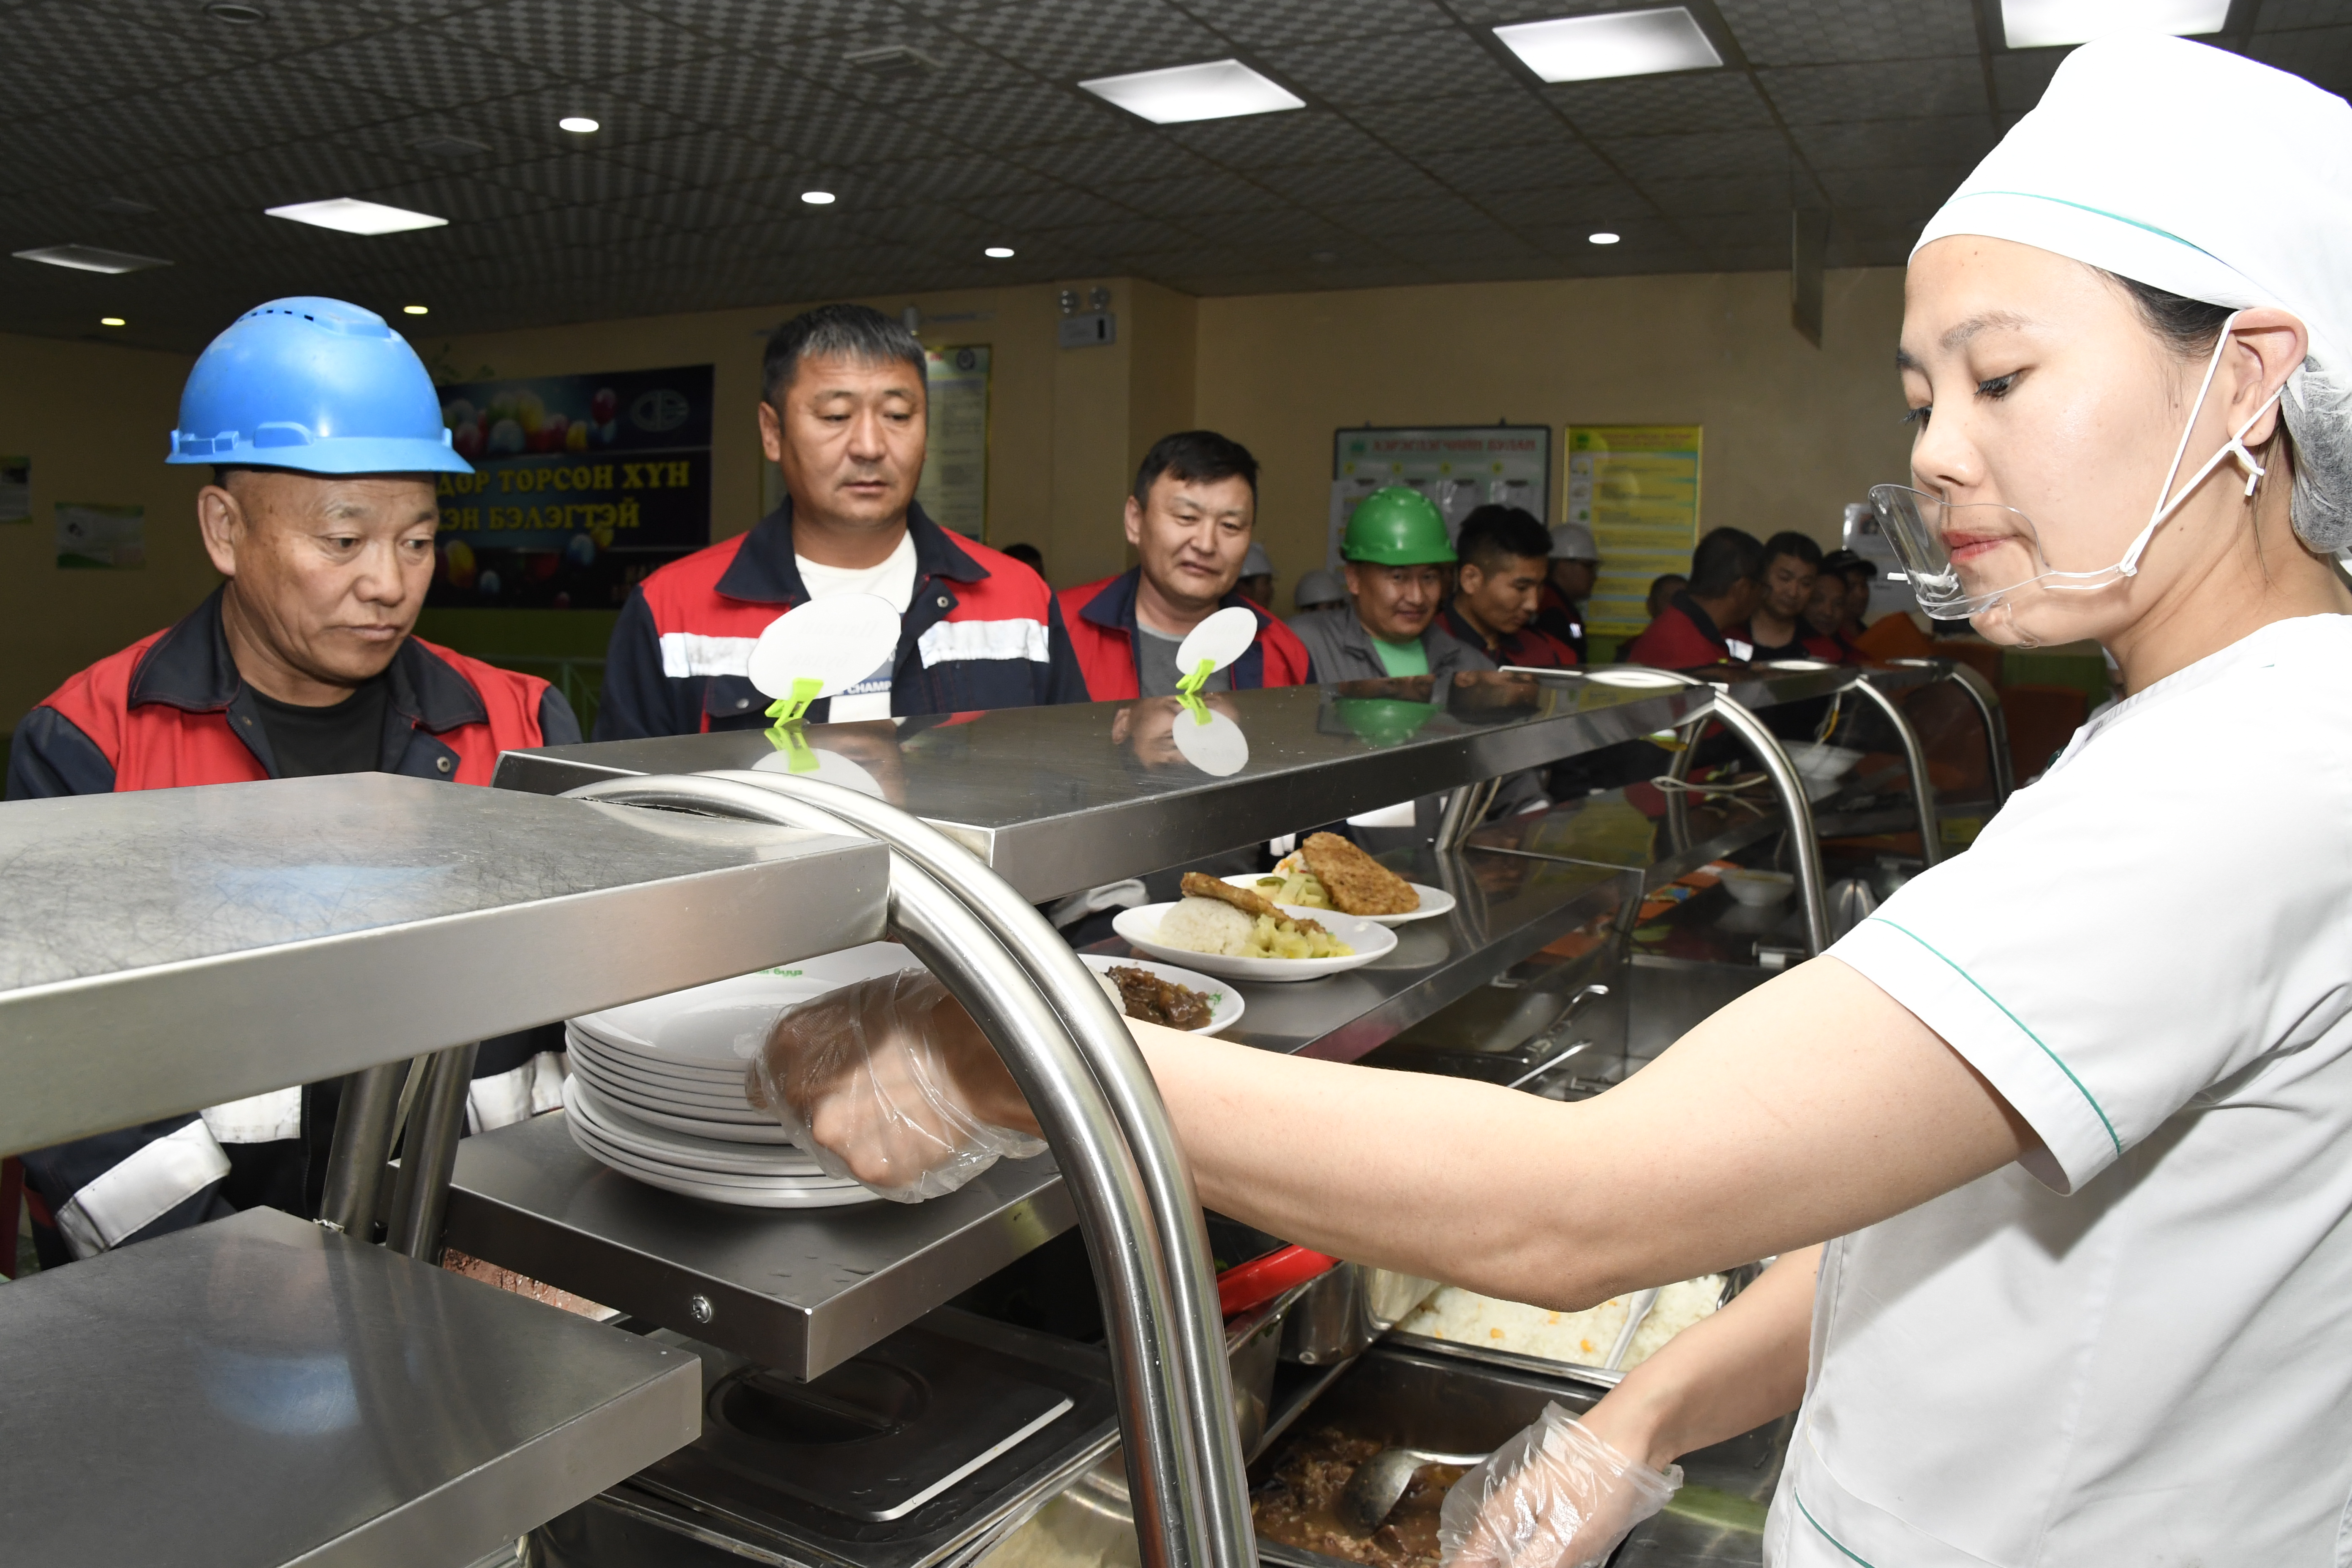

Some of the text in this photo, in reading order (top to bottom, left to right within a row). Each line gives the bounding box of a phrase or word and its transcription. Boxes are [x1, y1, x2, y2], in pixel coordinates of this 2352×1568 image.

[499, 466, 613, 493] ТӨРСӨН
[622, 462, 690, 488] ХҮН
[490, 497, 640, 530] БЭЛЭГТЭЙ
